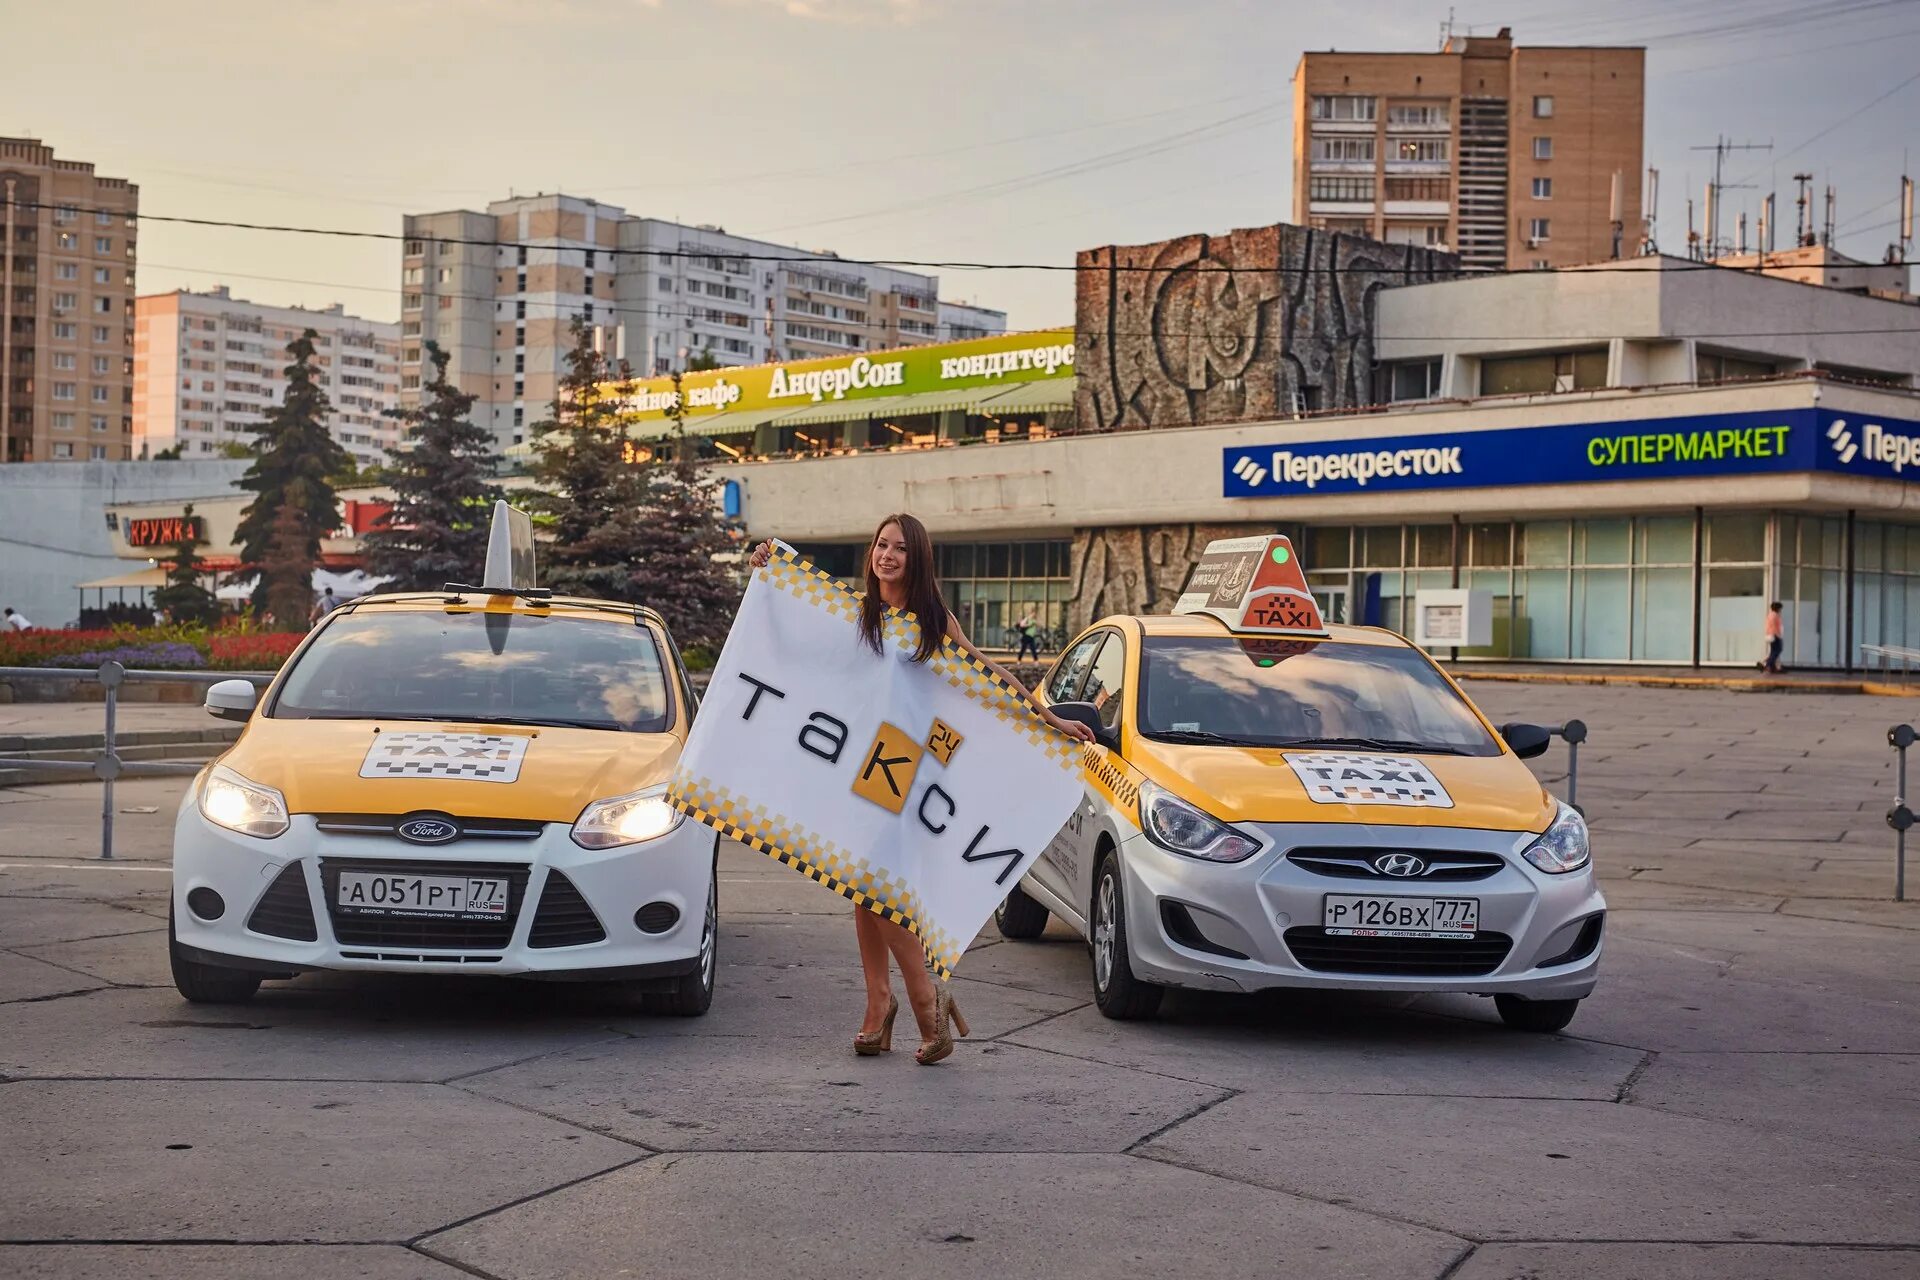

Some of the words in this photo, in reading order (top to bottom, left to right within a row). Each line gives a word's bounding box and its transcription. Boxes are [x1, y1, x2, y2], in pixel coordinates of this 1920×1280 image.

[940, 343, 1075, 380] кондитерс
[688, 378, 739, 410] кафе
[1587, 425, 1791, 466] СУПЕРМАРКЕТ
[1272, 446, 1463, 489] Перекресток
[1253, 609, 1311, 627] TAXI
[384, 745, 511, 760] TAXI
[926, 722, 961, 763] 24
[1306, 767, 1427, 783] TAXI
[411, 822, 444, 837] Ford
[471, 881, 498, 901] 77
[468, 900, 489, 910] RUS
[1435, 901, 1472, 921] 777
[1442, 920, 1460, 928] RUS
